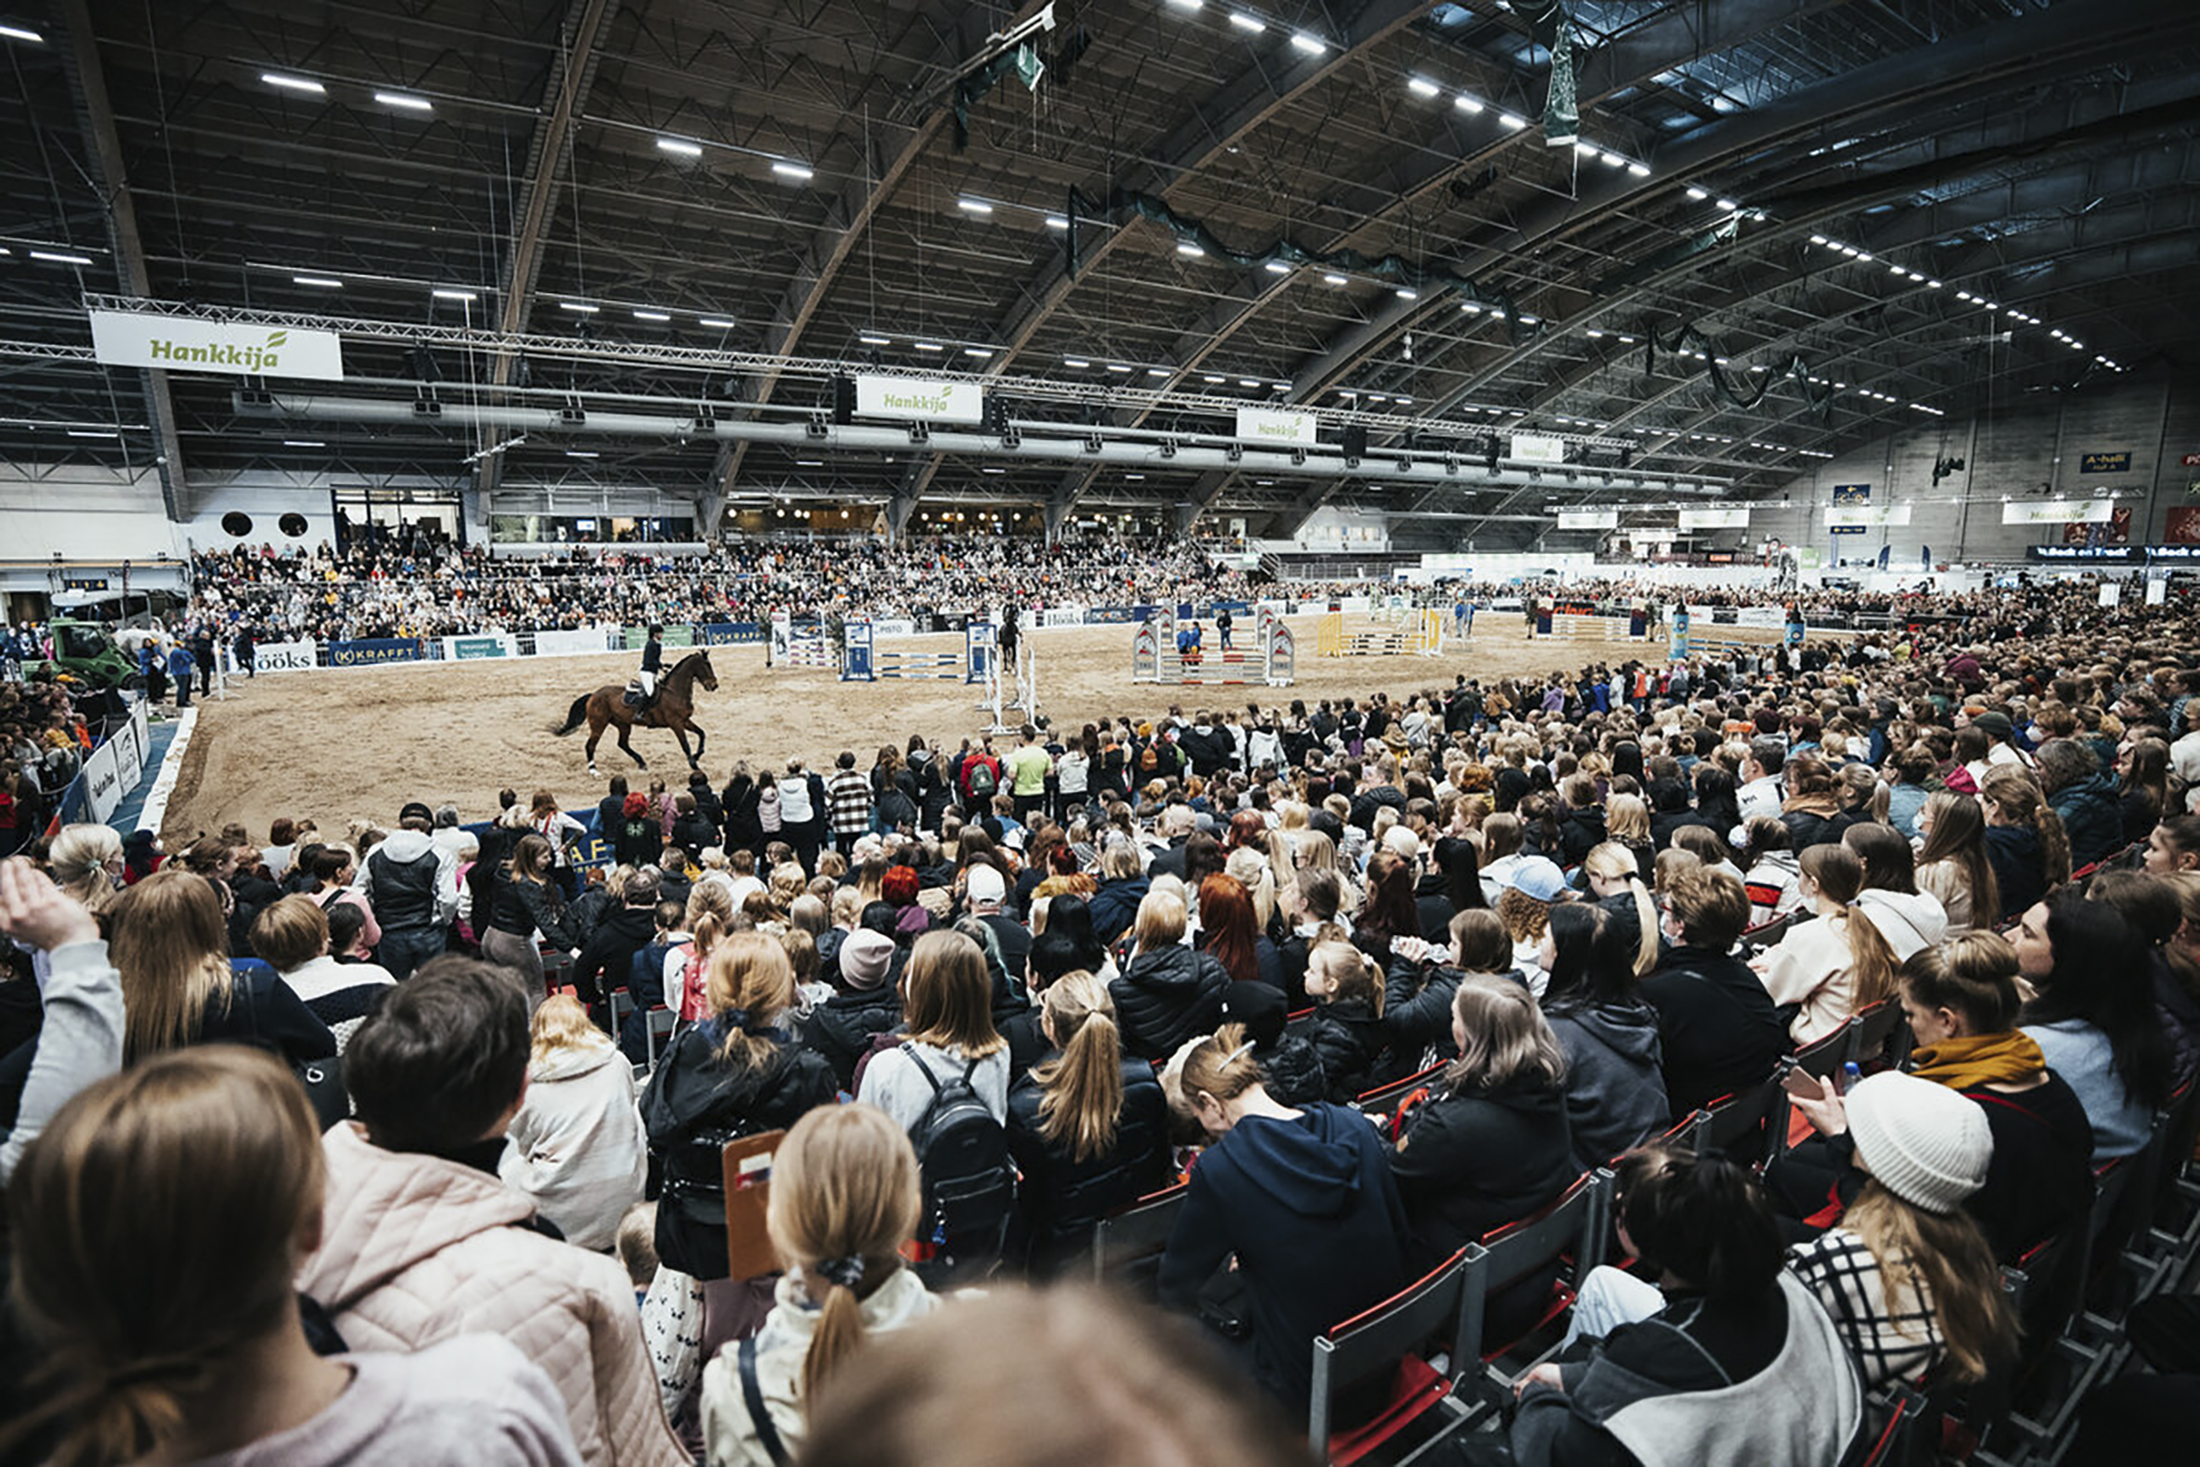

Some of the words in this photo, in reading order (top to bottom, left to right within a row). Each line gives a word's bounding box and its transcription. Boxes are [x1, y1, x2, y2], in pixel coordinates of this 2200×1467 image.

[150, 339, 278, 372] Hankkija
[884, 394, 947, 414] Hankkija
[257, 652, 311, 671] ööks
[356, 648, 413, 660] KRAFFT
